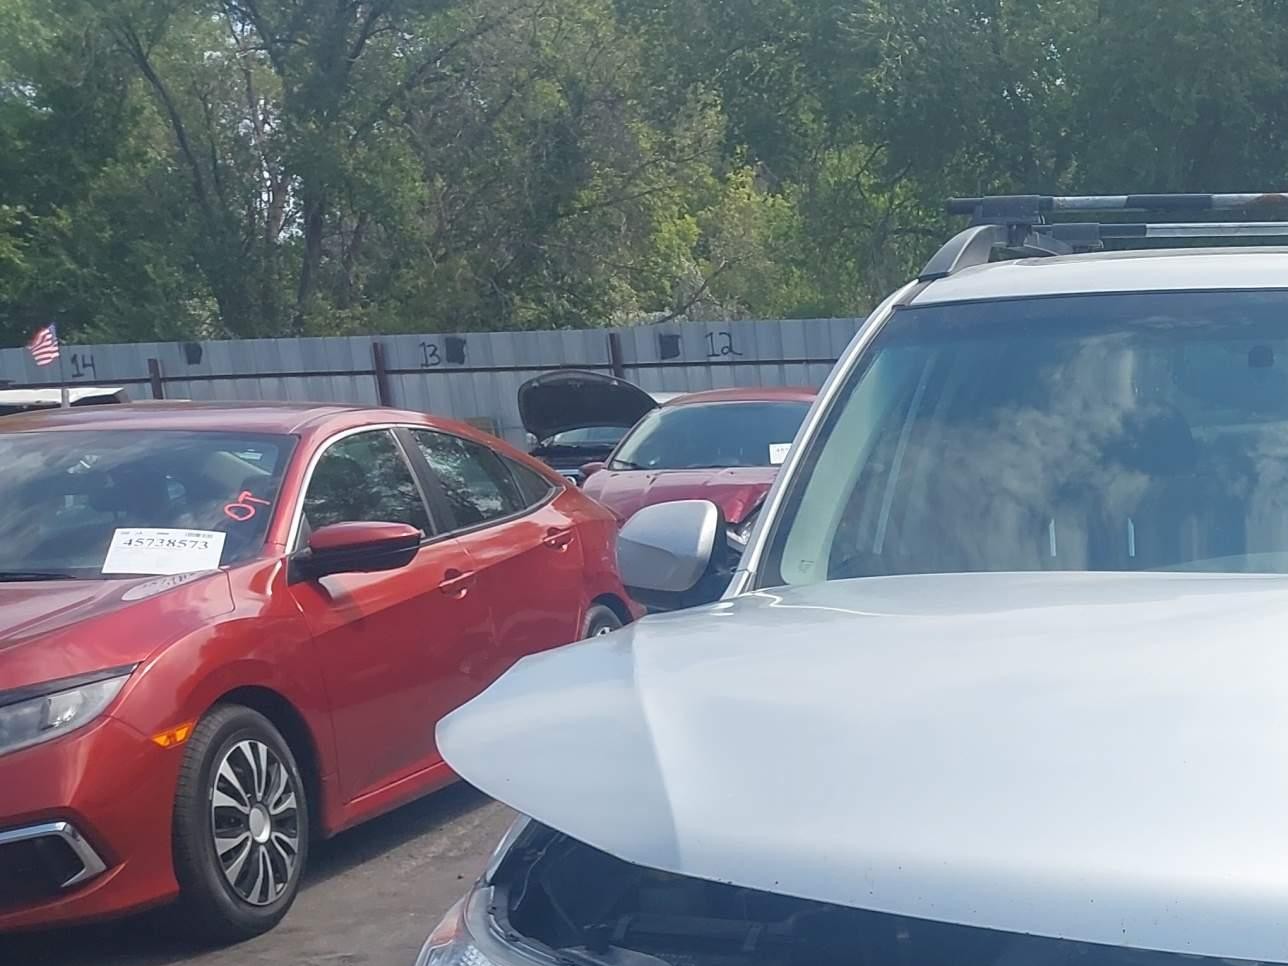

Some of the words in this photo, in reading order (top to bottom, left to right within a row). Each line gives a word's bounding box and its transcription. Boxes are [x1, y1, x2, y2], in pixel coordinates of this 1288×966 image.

[705, 332, 743, 357] 12
[71, 353, 97, 379] 14
[122, 537, 209, 550] 45738573
